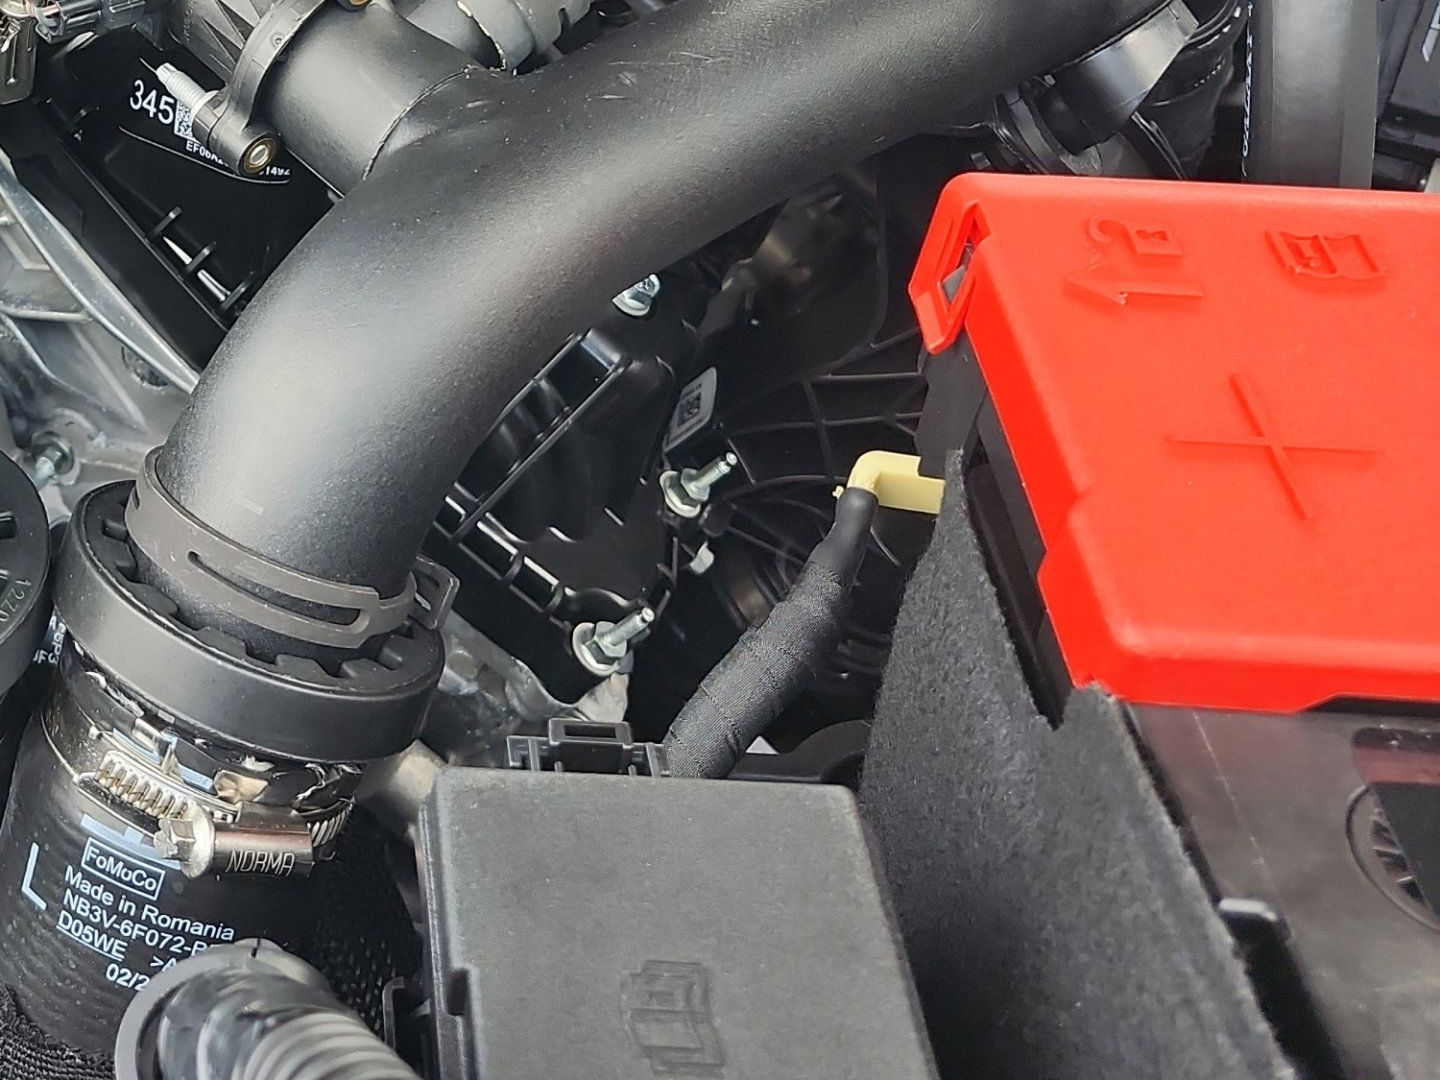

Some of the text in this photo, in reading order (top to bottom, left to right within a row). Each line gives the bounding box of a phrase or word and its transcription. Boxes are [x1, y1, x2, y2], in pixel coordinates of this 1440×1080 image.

[129, 79, 175, 125] 345
[21, 841, 47, 911] L
[86, 847, 157, 892] FoMoCo
[224, 848, 296, 877] NORMA
[64, 865, 235, 942] Made in Romania
[58, 910, 129, 959] D05WE
[105, 963, 151, 993] 02/2
